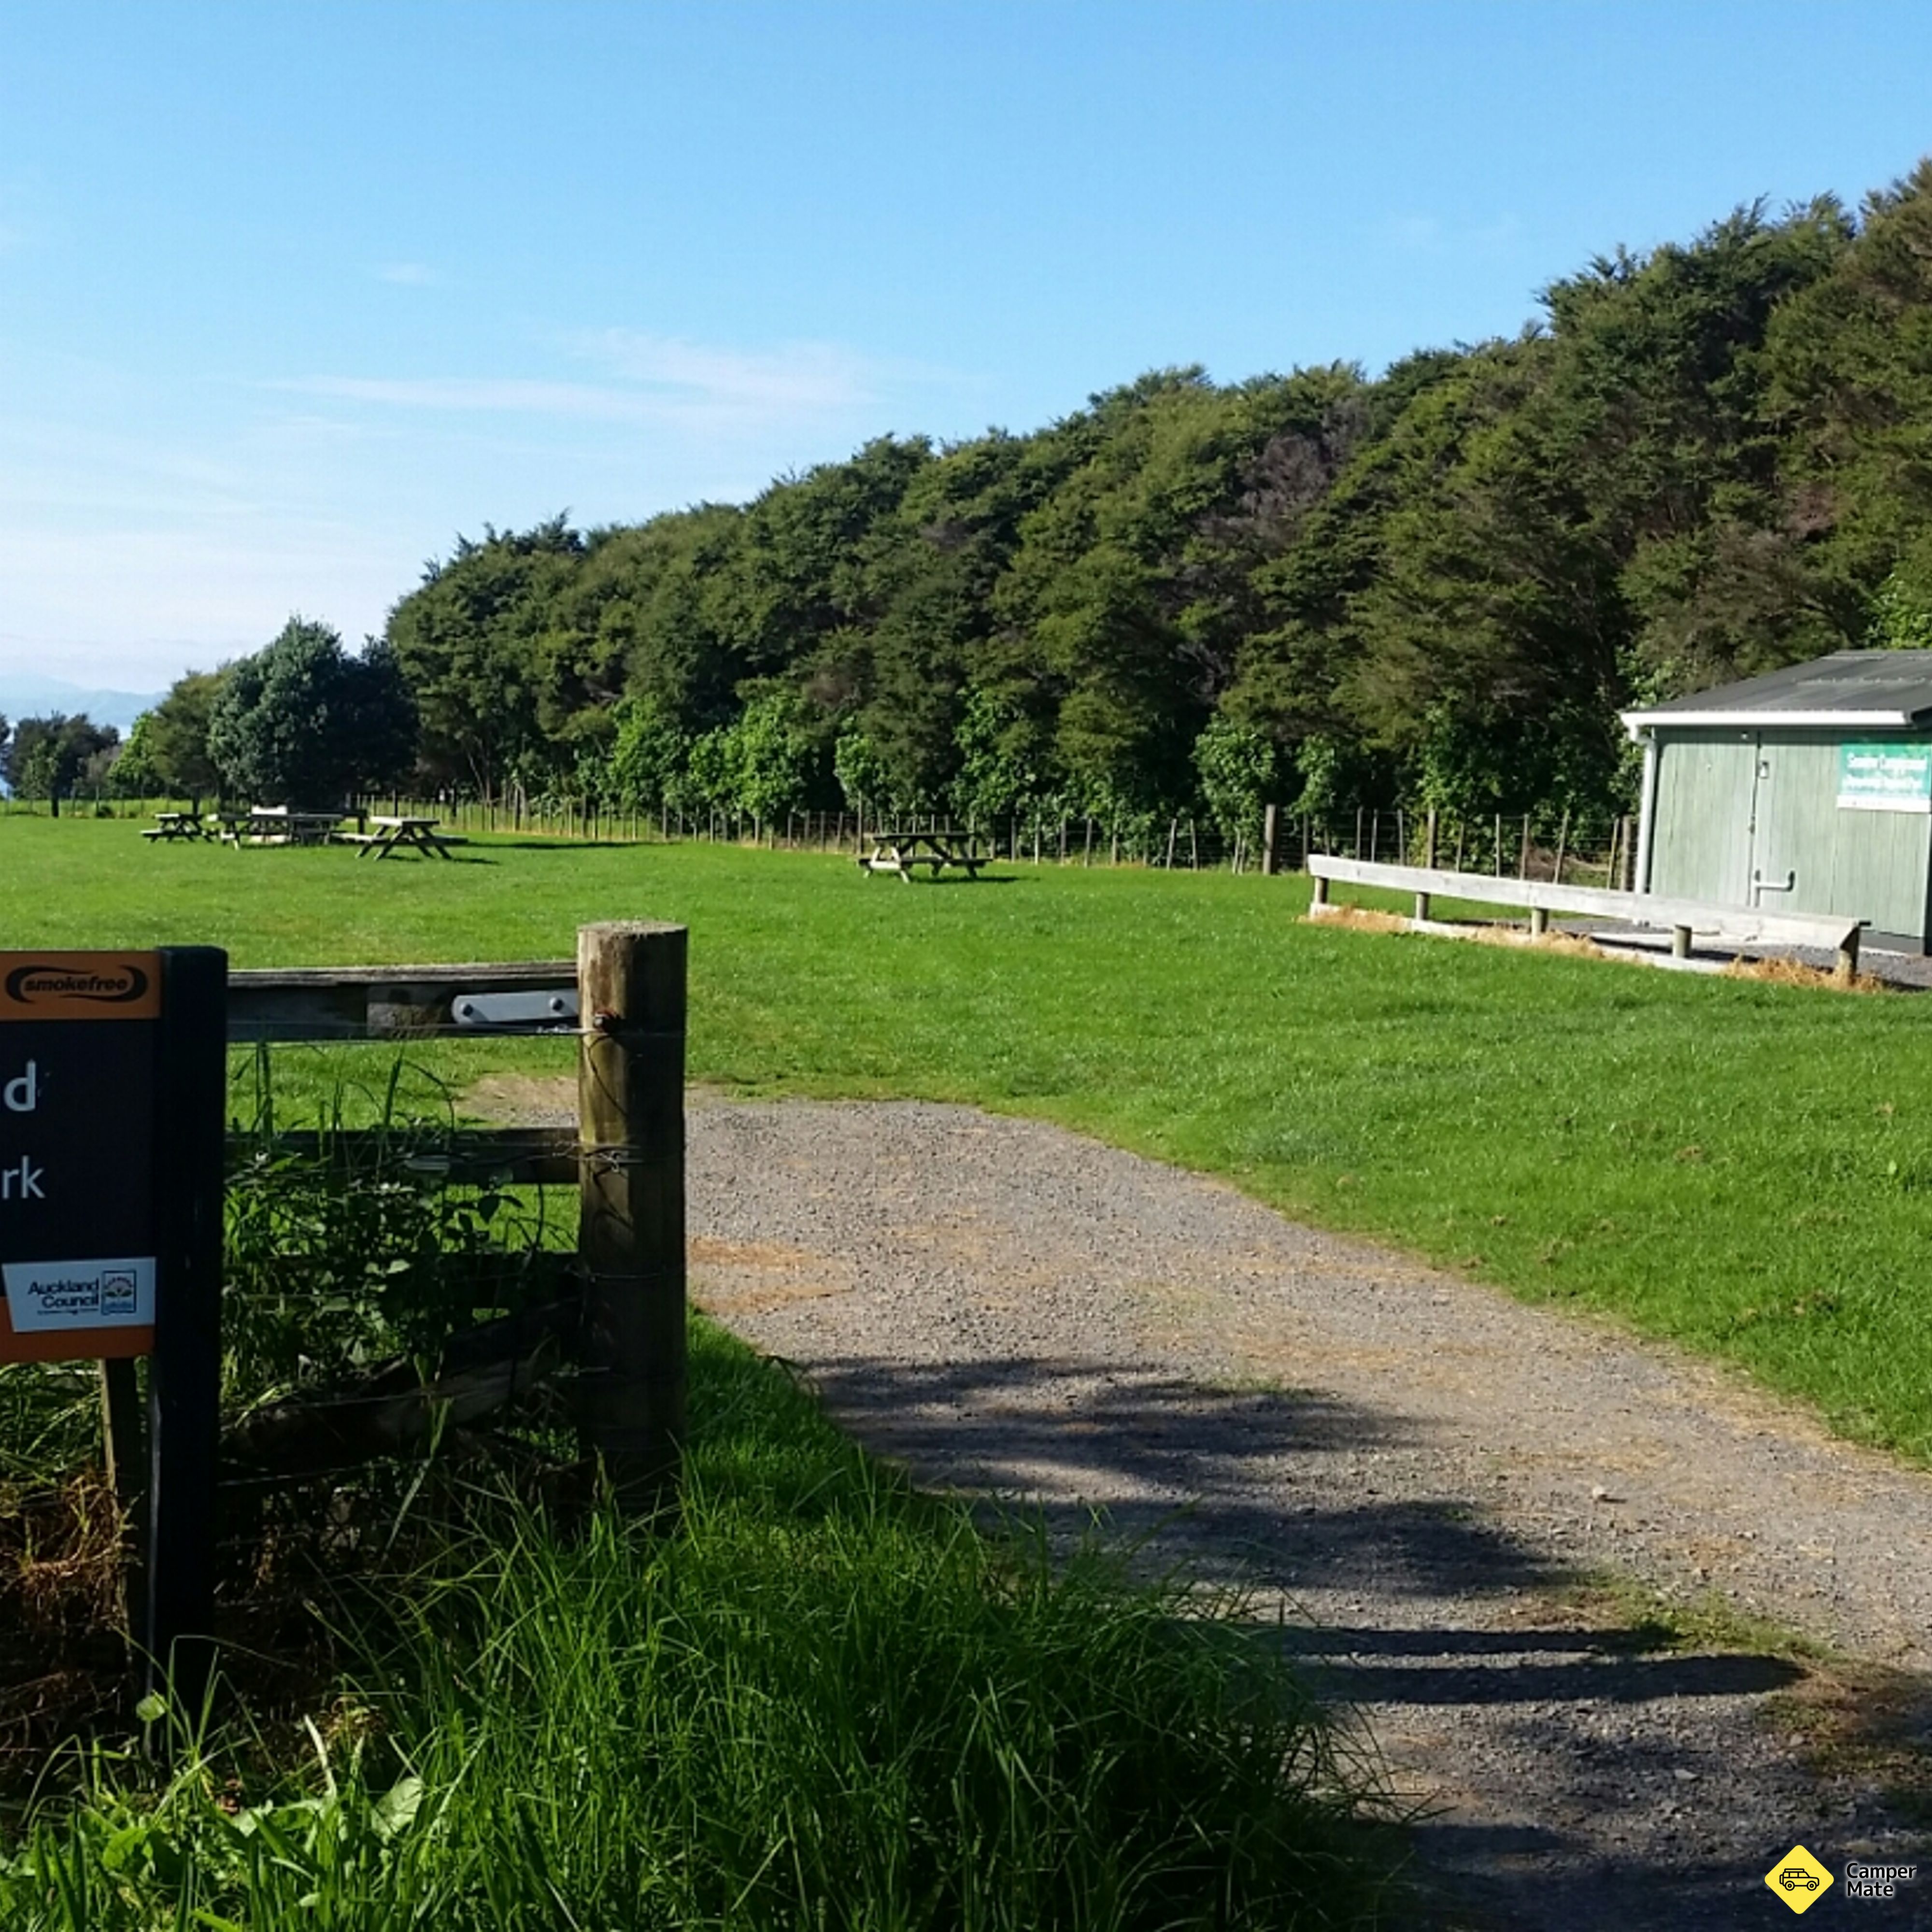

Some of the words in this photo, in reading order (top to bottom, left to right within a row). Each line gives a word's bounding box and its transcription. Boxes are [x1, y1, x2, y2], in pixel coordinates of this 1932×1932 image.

[24, 976, 128, 992] smokefree
[28, 1278, 99, 1295] Auckland
[42, 1292, 99, 1308] Council
